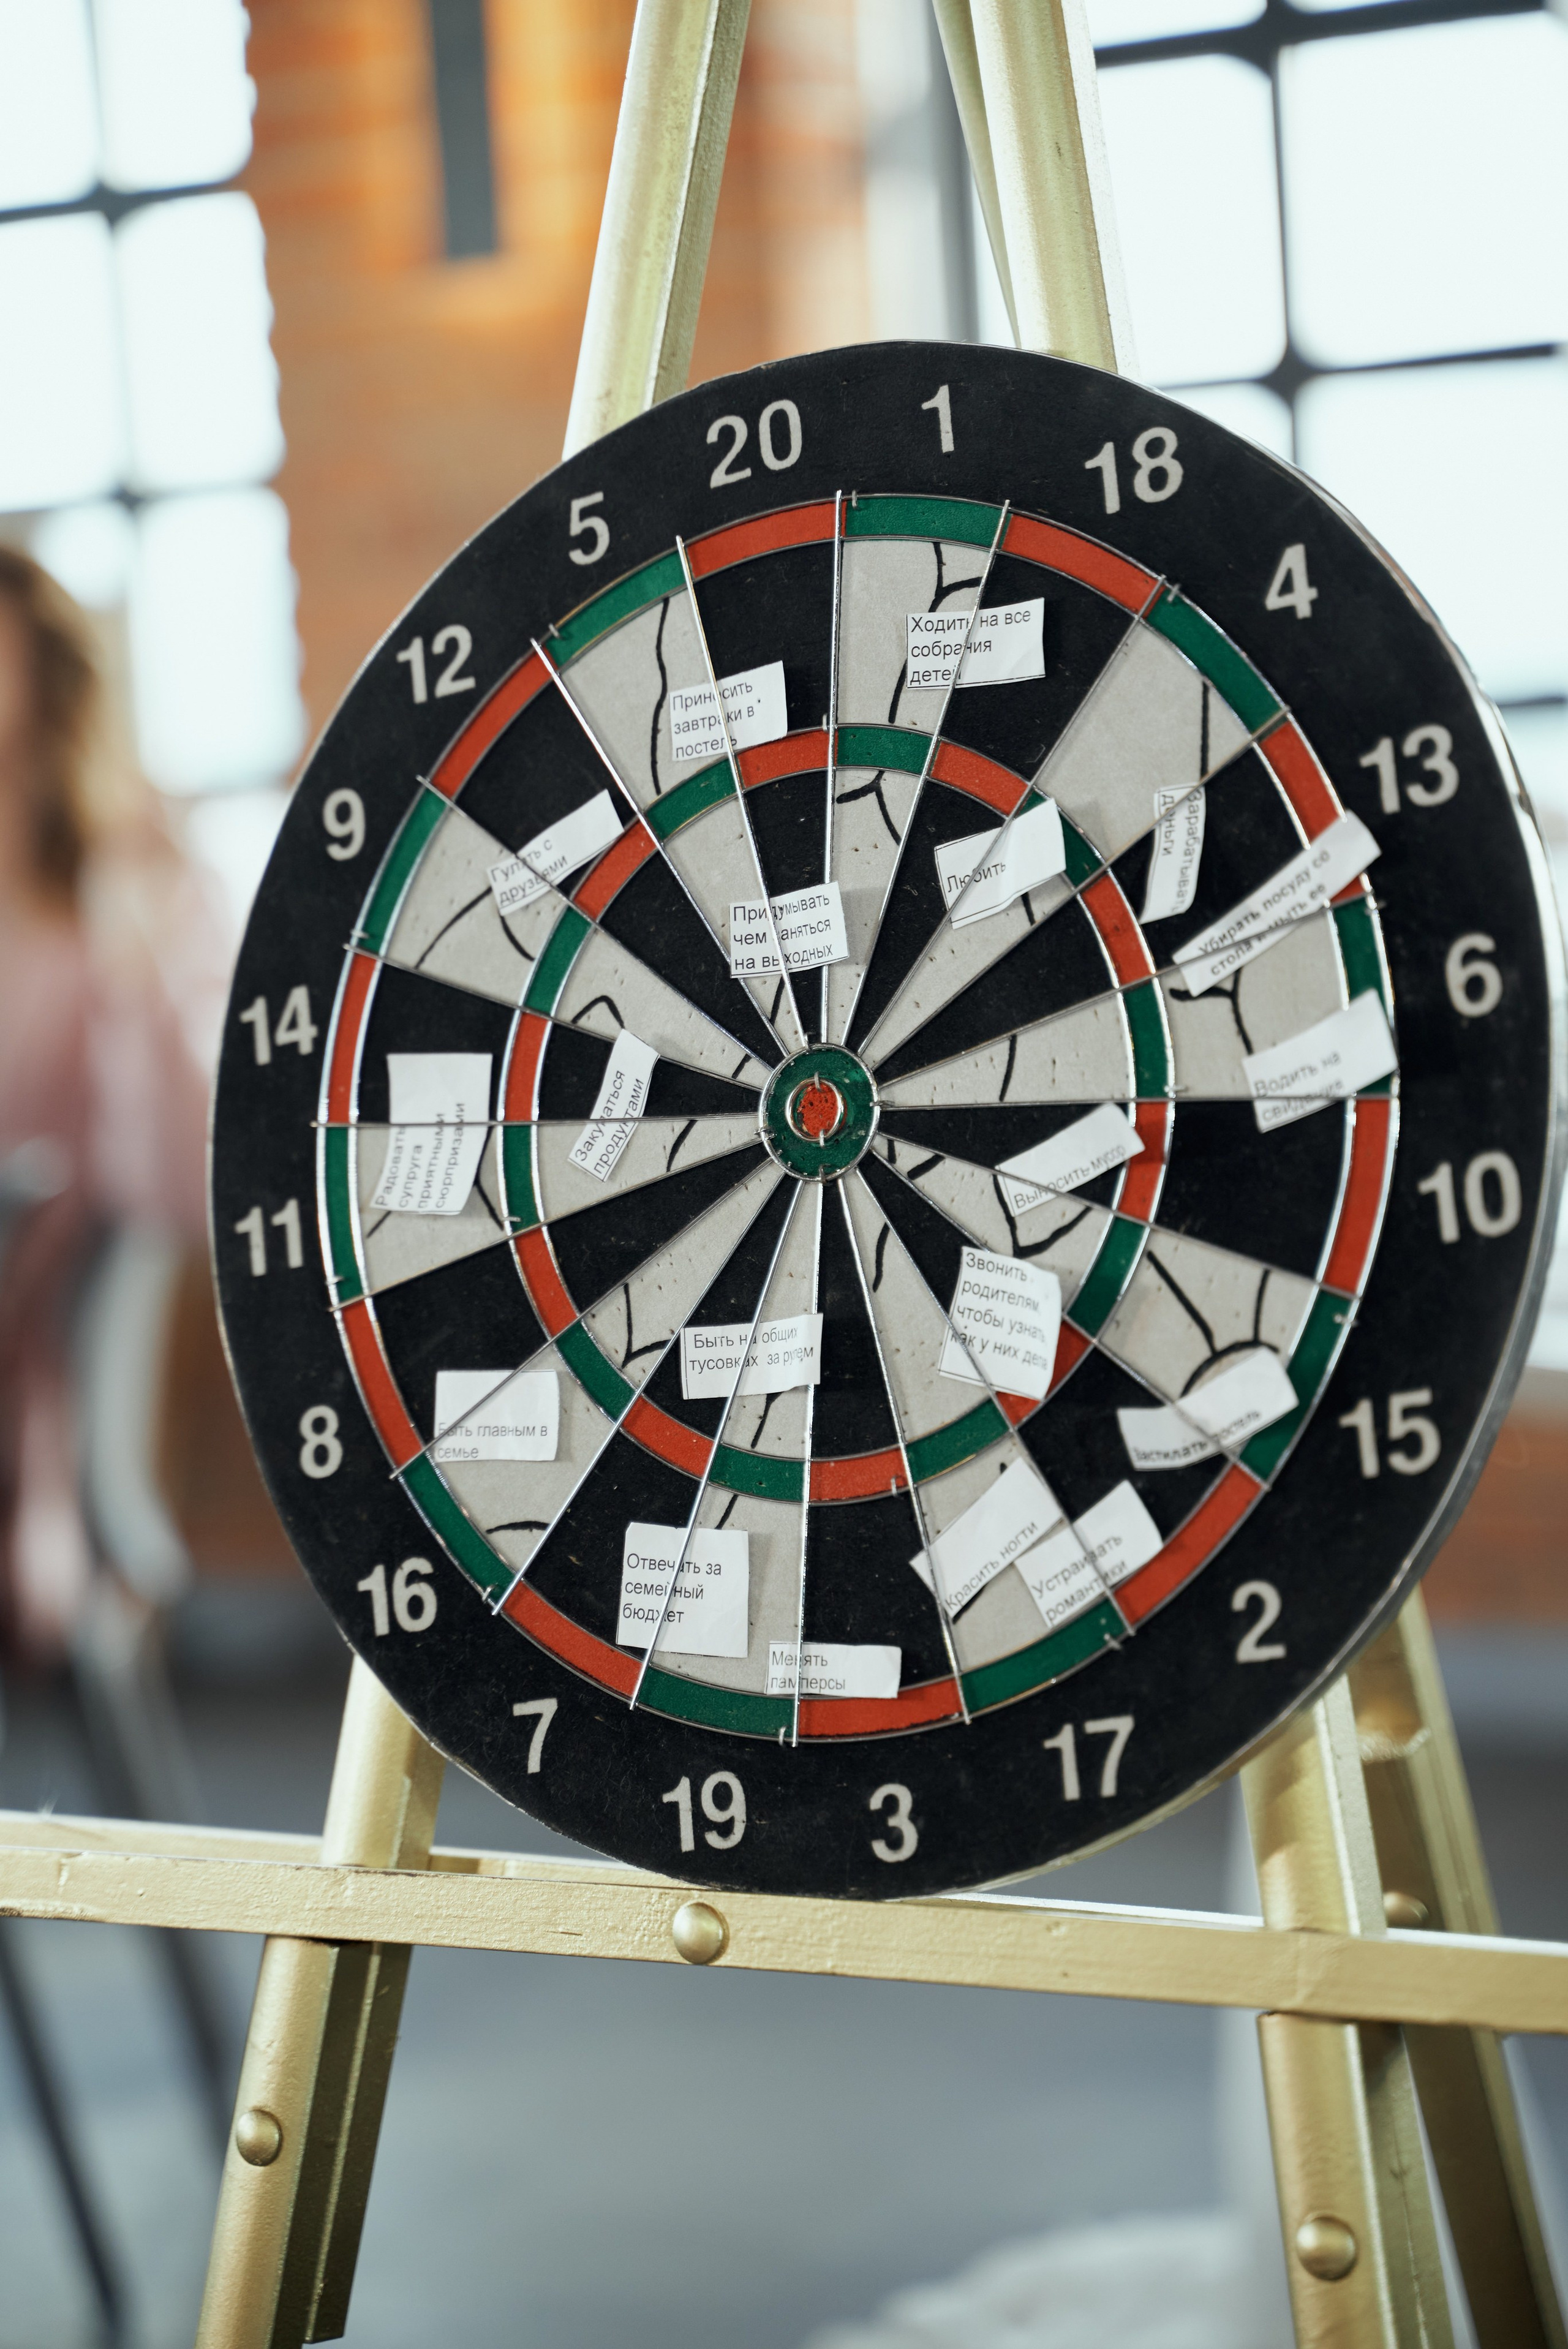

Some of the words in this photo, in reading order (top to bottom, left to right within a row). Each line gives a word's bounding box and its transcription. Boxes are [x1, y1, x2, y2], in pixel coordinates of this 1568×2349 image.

[706, 398, 803, 489] 20
[921, 383, 955, 454] 1
[1084, 426, 1184, 515] 18
[568, 491, 611, 566] 5
[1264, 543, 1318, 619] 4
[911, 641, 992, 660] собрания
[980, 614, 998, 628] на
[1005, 610, 1031, 625] все
[396, 624, 476, 704] 12
[747, 706, 755, 717] в
[676, 736, 737, 758] постель
[1360, 725, 1459, 813] 13
[323, 788, 366, 861] 9
[543, 840, 552, 851] с
[499, 856, 568, 906] друзьями
[734, 894, 830, 924] Придумывать
[947, 862, 1006, 892] Любить
[1199, 911, 1261, 954] Убирать
[1262, 869, 1312, 910] посуду
[1313, 850, 1331, 869] со
[733, 932, 767, 945] чем
[777, 919, 831, 941] аняться
[734, 957, 755, 970] на
[762, 944, 833, 968] выходных
[1210, 940, 1254, 976] стола
[1446, 933, 1502, 1017] 6
[240, 985, 318, 1065] 14
[1254, 1065, 1317, 1098] Водить
[1262, 1078, 1344, 1122] свидия
[575, 1070, 625, 1162] Закупаться
[375, 1125, 407, 1207] Радовать
[399, 1144, 423, 1208] супруга
[417, 1112, 445, 1209] приятными
[435, 1103, 466, 1208] сюрпризами
[1014, 1166, 1090, 1210] Выносить
[1090, 1144, 1127, 1172] мусор
[1419, 1152, 1521, 1242] 10
[235, 1198, 303, 1277] 11
[966, 1252, 1028, 1282] Звонить
[693, 1333, 734, 1349] Быть
[762, 1327, 798, 1343] общих
[951, 1330, 976, 1348] как
[979, 1338, 989, 1354] у
[993, 1341, 1020, 1359] них
[957, 1305, 1005, 1329] чтобы
[689, 1355, 758, 1374] тусовках
[767, 1352, 780, 1365] за
[300, 1404, 343, 1479] 8
[437, 1447, 479, 1458] семье
[477, 1425, 535, 1437] главным
[540, 1426, 548, 1436] в
[1340, 1389, 1440, 1477] 15
[356, 1556, 437, 1637] 16
[627, 1553, 701, 1574] Отвечать
[706, 1563, 722, 1575] за
[945, 1561, 999, 1610] Красить
[1000, 1521, 1038, 1560] ногти
[1031, 1535, 1123, 1599] Устраивать
[1046, 1561, 1128, 1622] романтики
[1232, 1580, 1286, 1663] 2
[771, 1677, 845, 1693] памперсы
[512, 1697, 559, 1774] 7
[1043, 1715, 1134, 1801] 17
[662, 1770, 747, 1853] 19
[869, 1783, 919, 1863] 3
